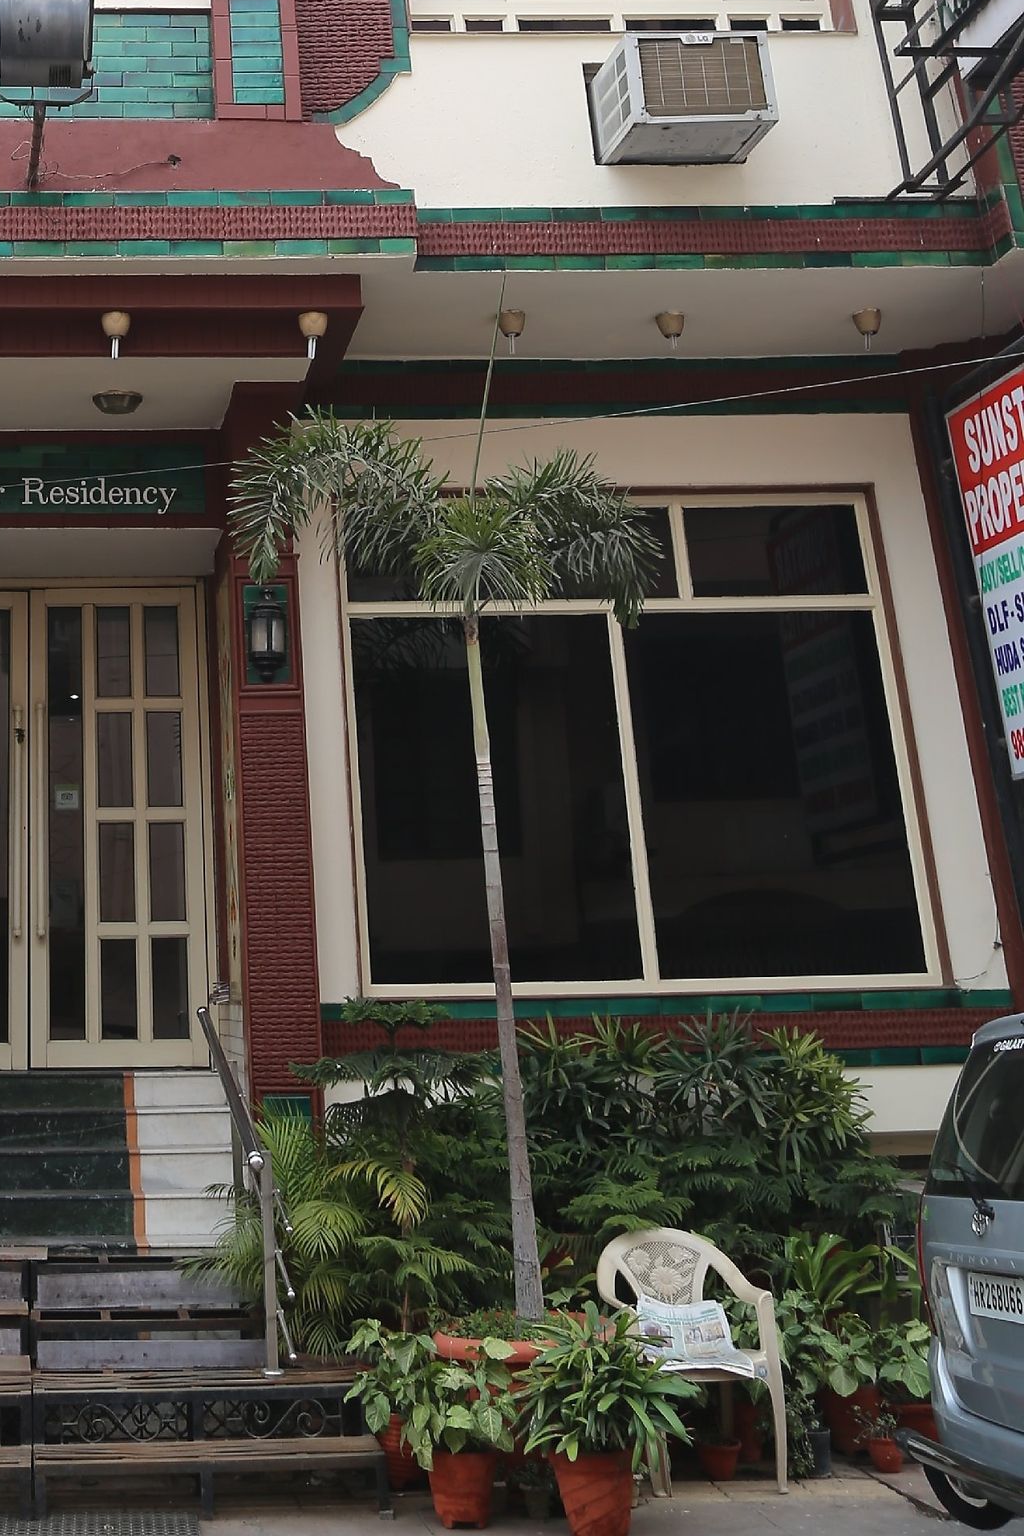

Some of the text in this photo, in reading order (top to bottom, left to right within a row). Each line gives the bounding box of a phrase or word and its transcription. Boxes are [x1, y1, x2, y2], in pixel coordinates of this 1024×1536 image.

[22, 477, 177, 514] Residency
[964, 459, 1024, 545] PROPE
[994, 641, 1021, 676] HUDA
[1010, 727, 1024, 760] 98
